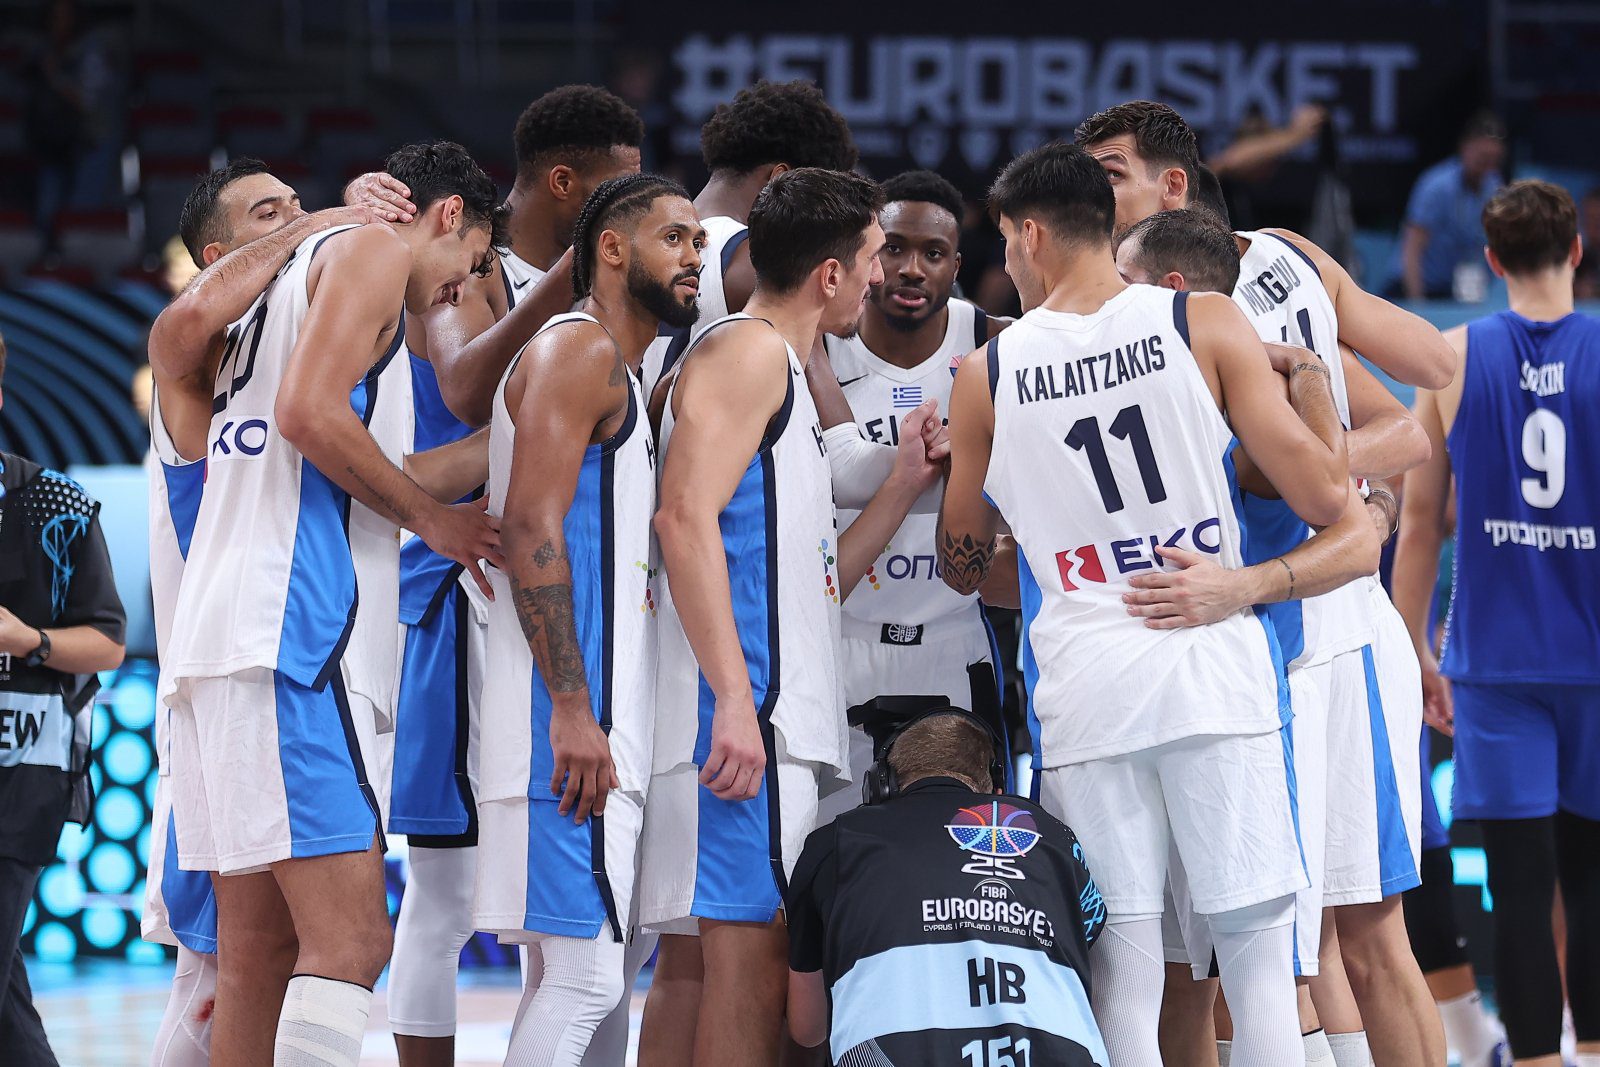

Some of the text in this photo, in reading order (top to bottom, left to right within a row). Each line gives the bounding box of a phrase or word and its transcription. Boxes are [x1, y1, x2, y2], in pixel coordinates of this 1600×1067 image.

[1015, 334, 1166, 405] KALAITZAKIS
[1064, 404, 1167, 514] 11
[1520, 408, 1566, 509] 9
[1110, 517, 1220, 574] EKO
[981, 886, 1008, 899] FIBA
[923, 924, 953, 932] CYPRUS
[959, 921, 991, 932] FINLAND
[998, 925, 1026, 936] POLAND
[967, 957, 1026, 1007] HB
[961, 1035, 1031, 1067] 151
